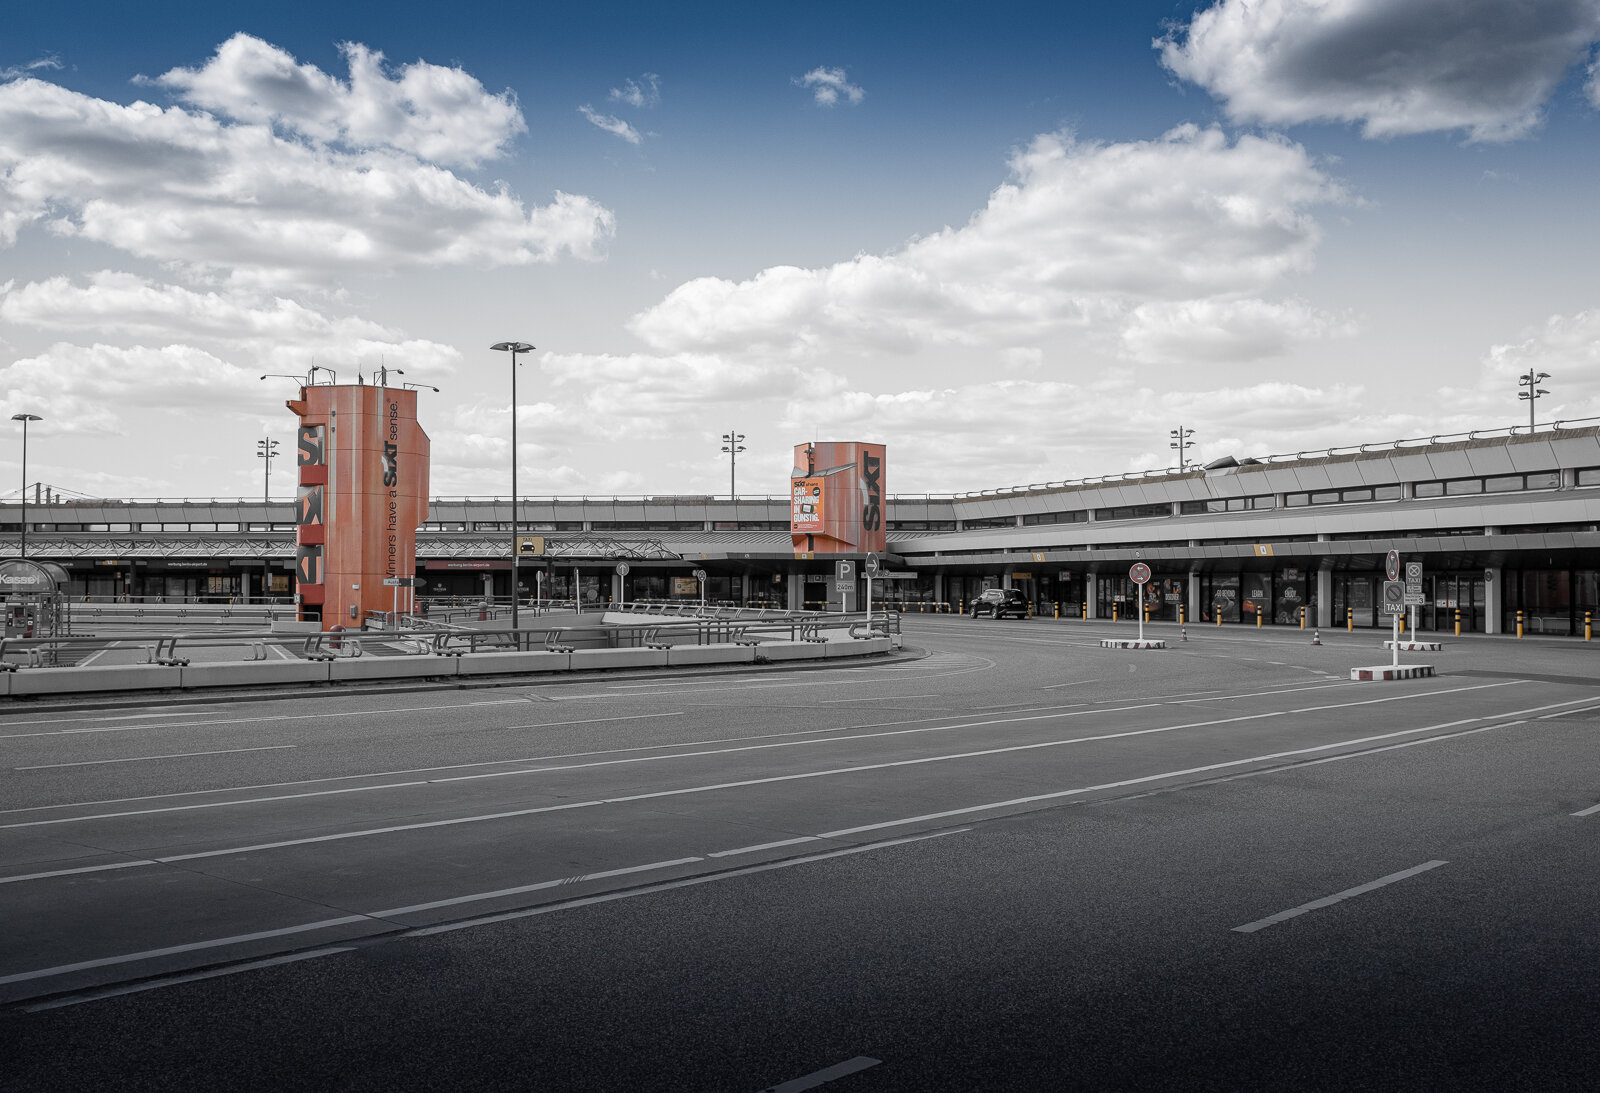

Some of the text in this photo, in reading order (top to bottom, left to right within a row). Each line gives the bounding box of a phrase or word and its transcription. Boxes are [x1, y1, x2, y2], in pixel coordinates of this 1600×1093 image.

[389, 490, 396, 498] a
[386, 501, 396, 531] have
[840, 563, 850, 579] P
